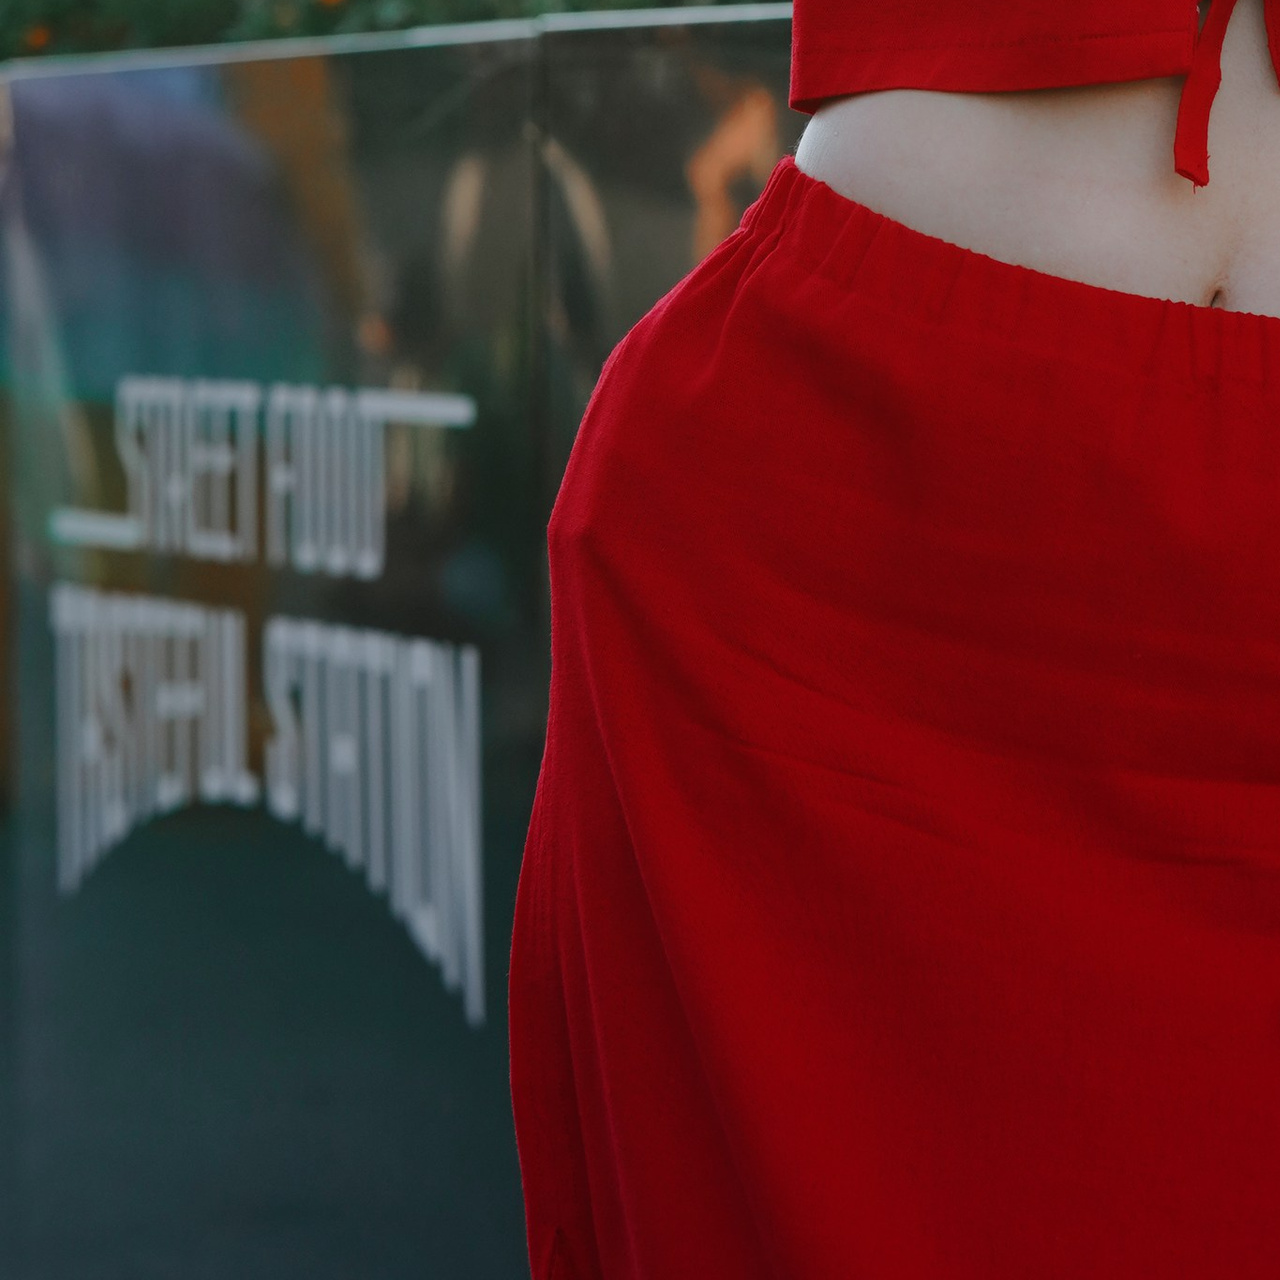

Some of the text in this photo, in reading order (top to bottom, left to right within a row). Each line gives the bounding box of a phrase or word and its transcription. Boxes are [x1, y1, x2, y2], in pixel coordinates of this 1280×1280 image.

[49, 376, 478, 579] STREET FOOD
[53, 583, 486, 1029] TASTEFUL STATION
